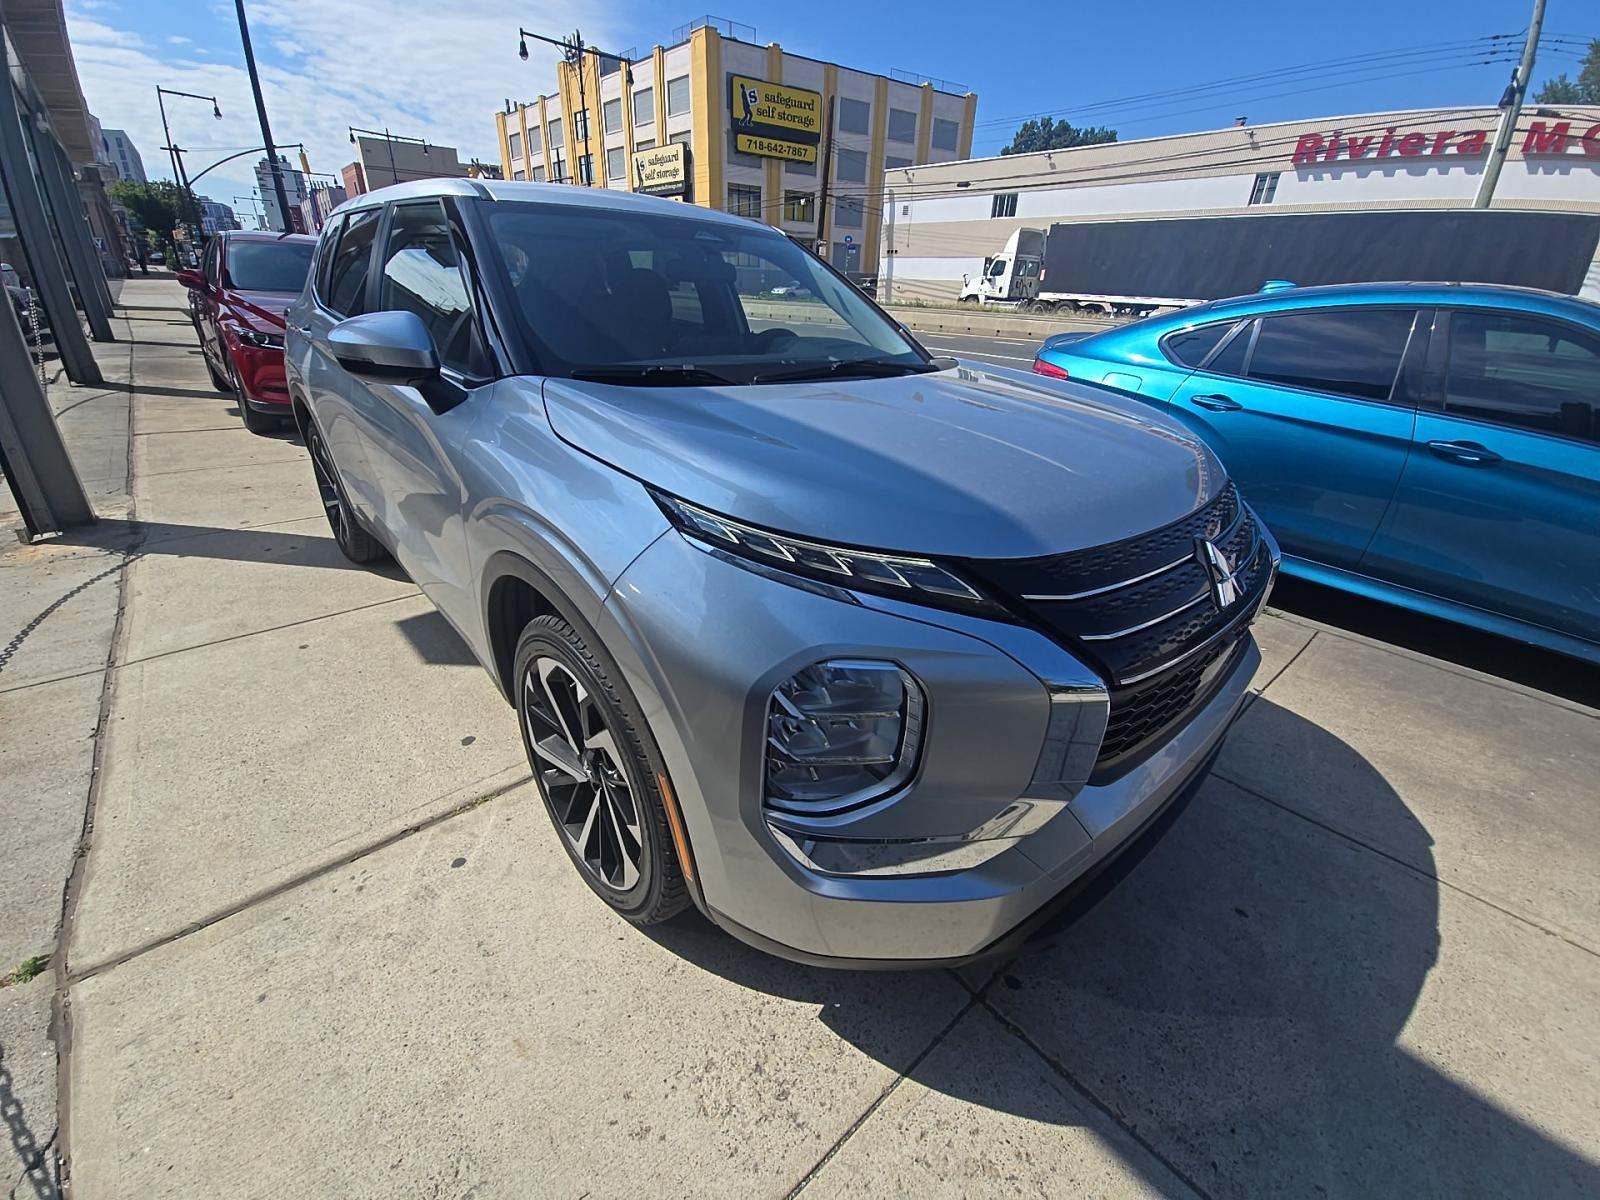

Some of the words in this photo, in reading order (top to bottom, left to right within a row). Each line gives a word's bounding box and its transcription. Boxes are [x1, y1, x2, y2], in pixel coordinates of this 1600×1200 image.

[764, 92, 815, 112] safeguard
[756, 106, 777, 119] self
[777, 110, 815, 128] storage
[746, 138, 808, 158] 718-642-7867
[1290, 127, 1486, 165] Riviera
[647, 150, 679, 167] safeguard
[644, 169, 656, 181] self
[656, 167, 680, 179] storage
